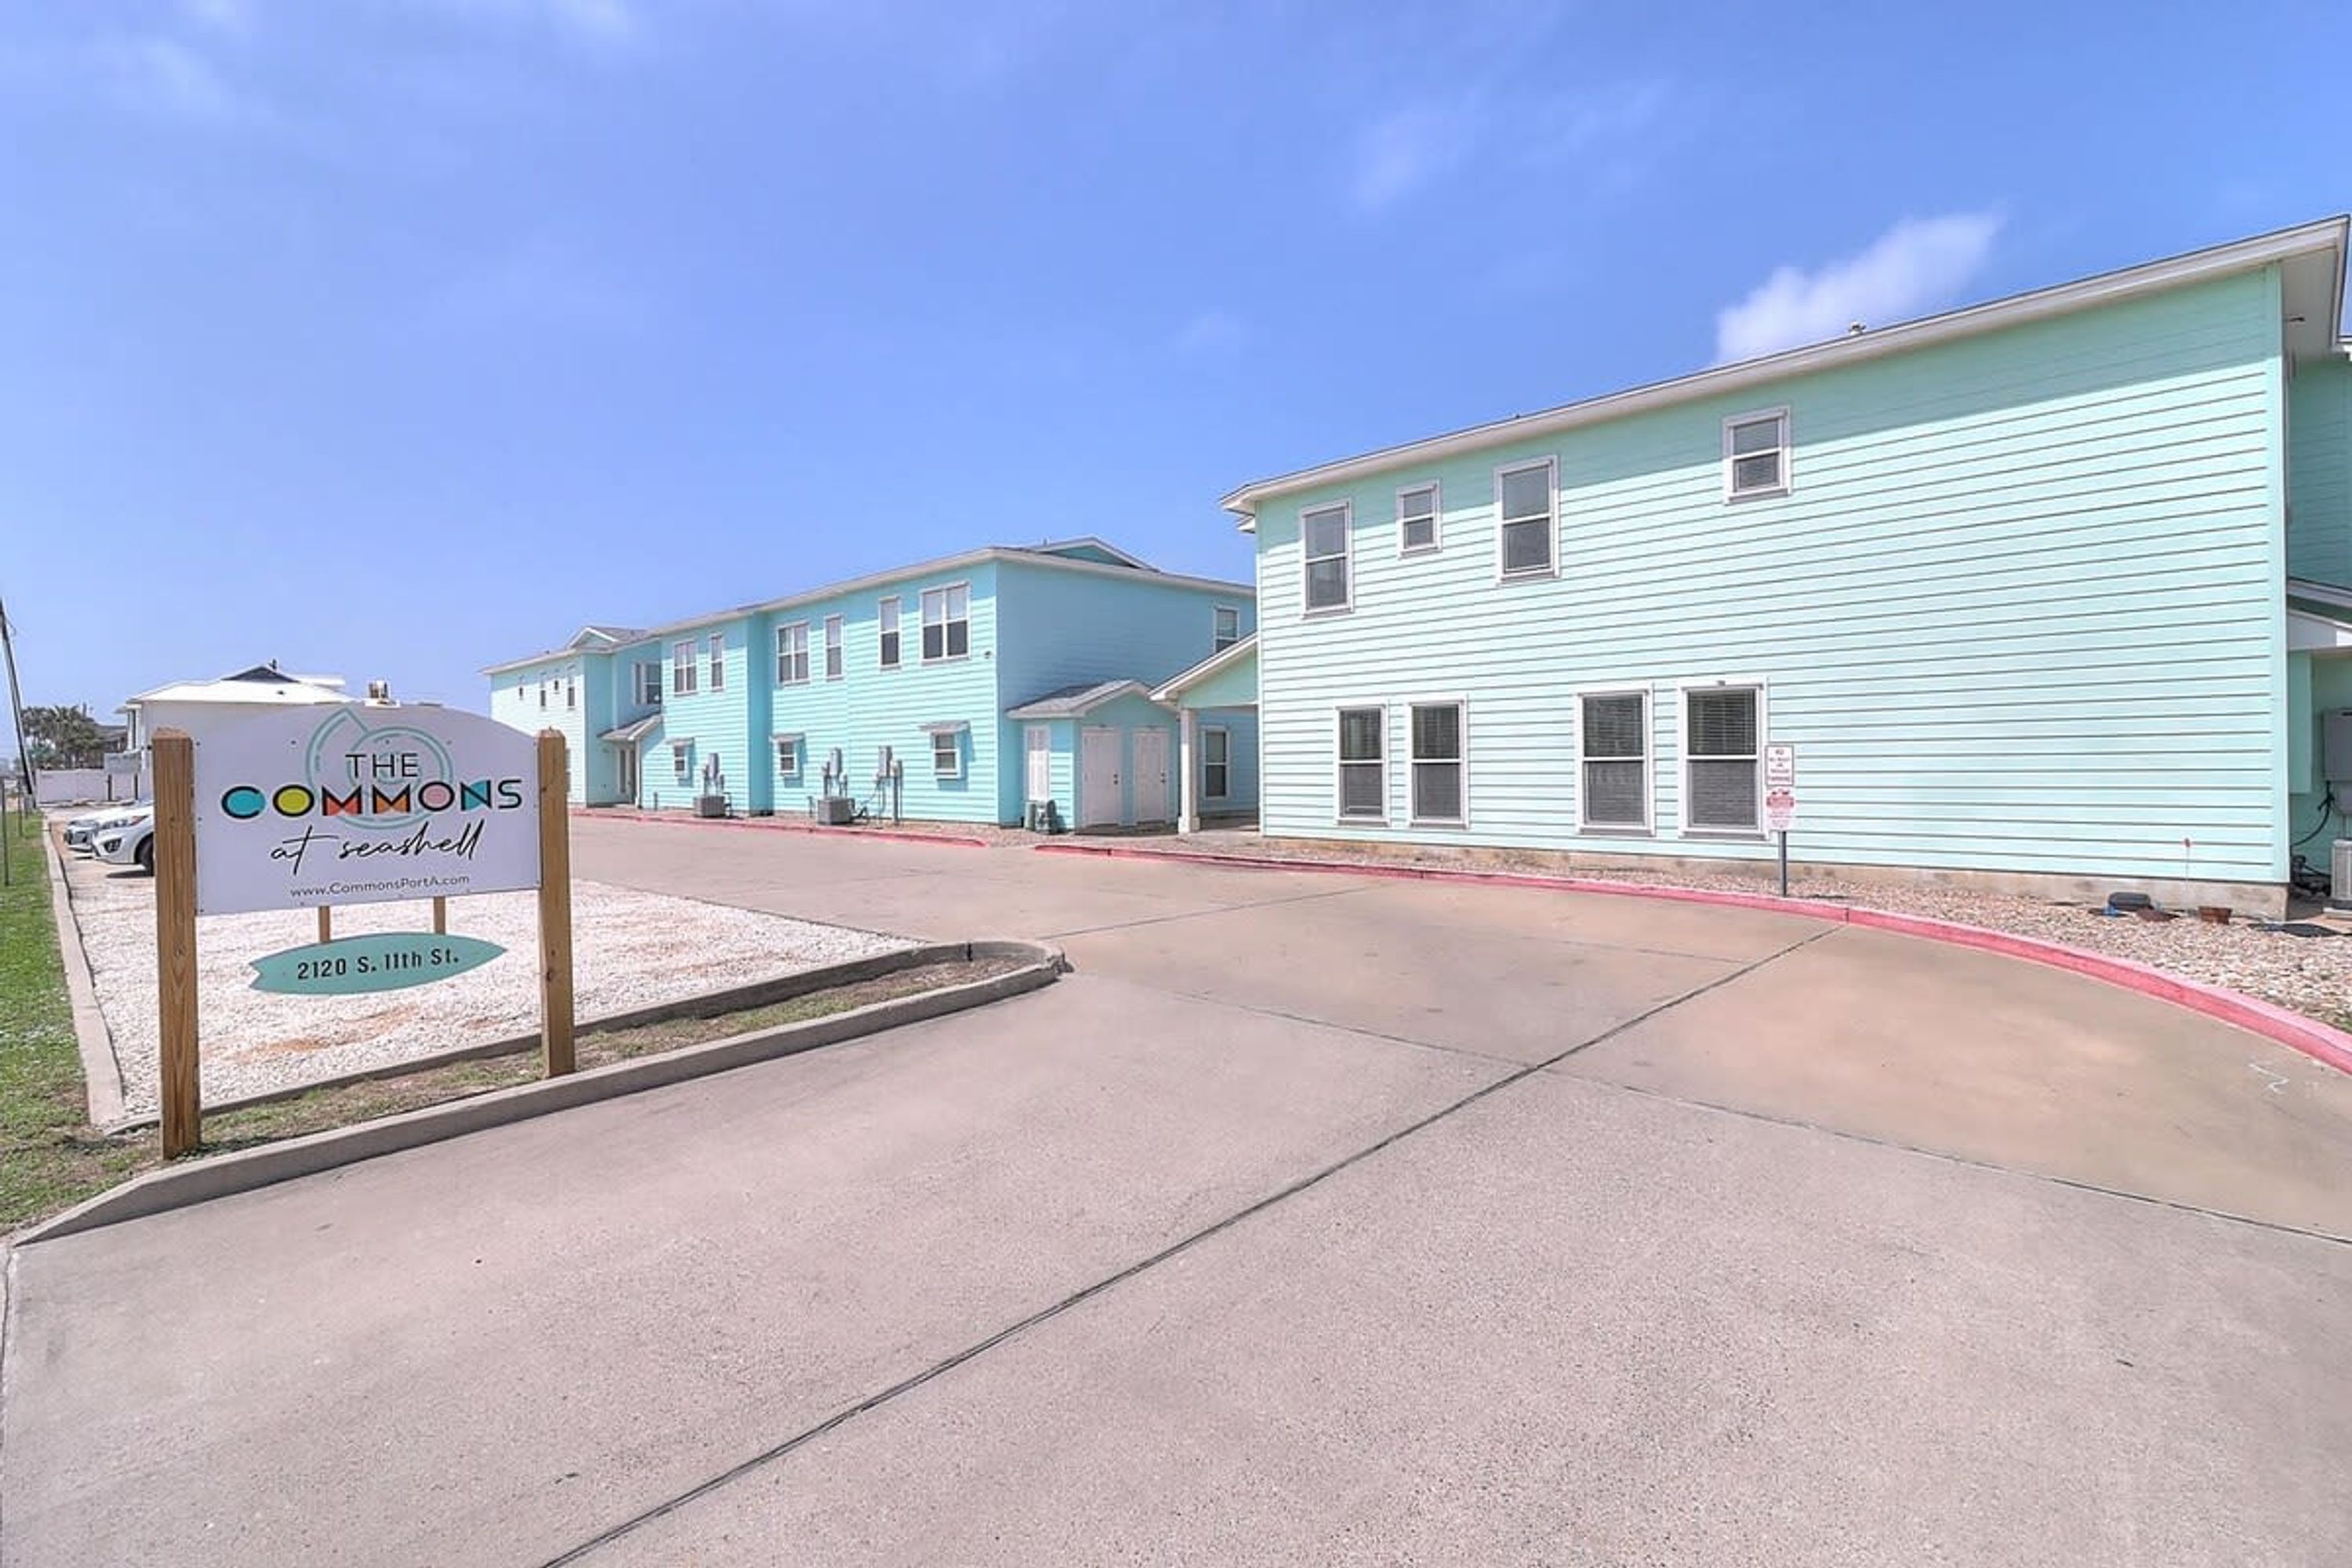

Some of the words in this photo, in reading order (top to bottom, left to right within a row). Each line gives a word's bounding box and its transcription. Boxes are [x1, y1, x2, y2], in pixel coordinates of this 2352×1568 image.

[345, 753, 419, 779] THE
[221, 780, 523, 820] COMMONS
[270, 824, 339, 875] at
[339, 818, 486, 860] seashell
[290, 874, 470, 898] www.CommonsPortA.com
[297, 958, 347, 980] 2120
[357, 954, 377, 973] S.
[384, 951, 422, 971] 11th
[430, 948, 459, 965] St.
